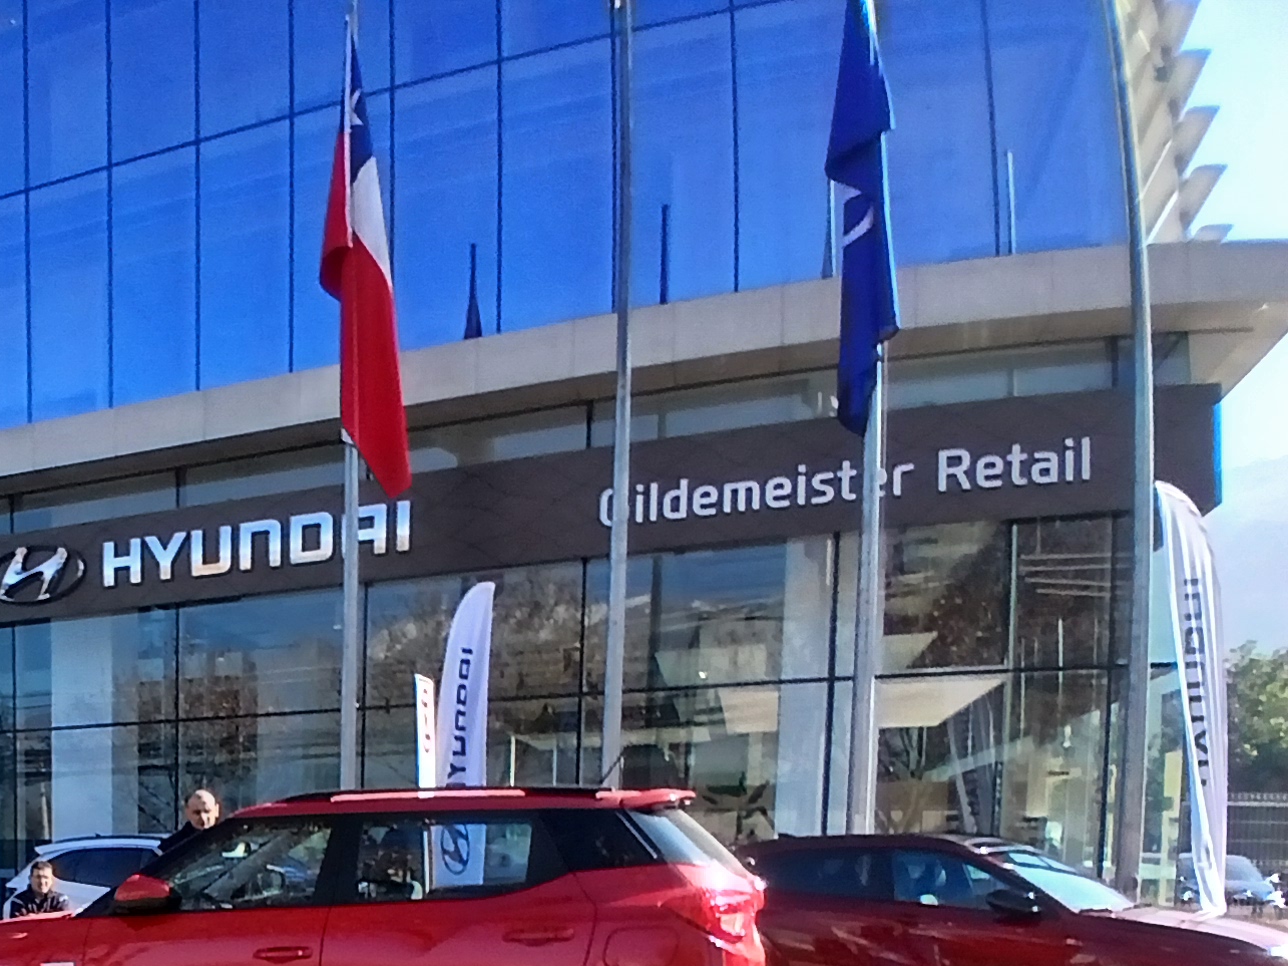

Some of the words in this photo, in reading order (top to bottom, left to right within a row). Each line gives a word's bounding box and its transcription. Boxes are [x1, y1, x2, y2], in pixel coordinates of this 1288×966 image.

[938, 437, 1091, 492] Retail
[102, 500, 410, 587] HYUNDAI
[445, 647, 473, 787] YUNDAI
